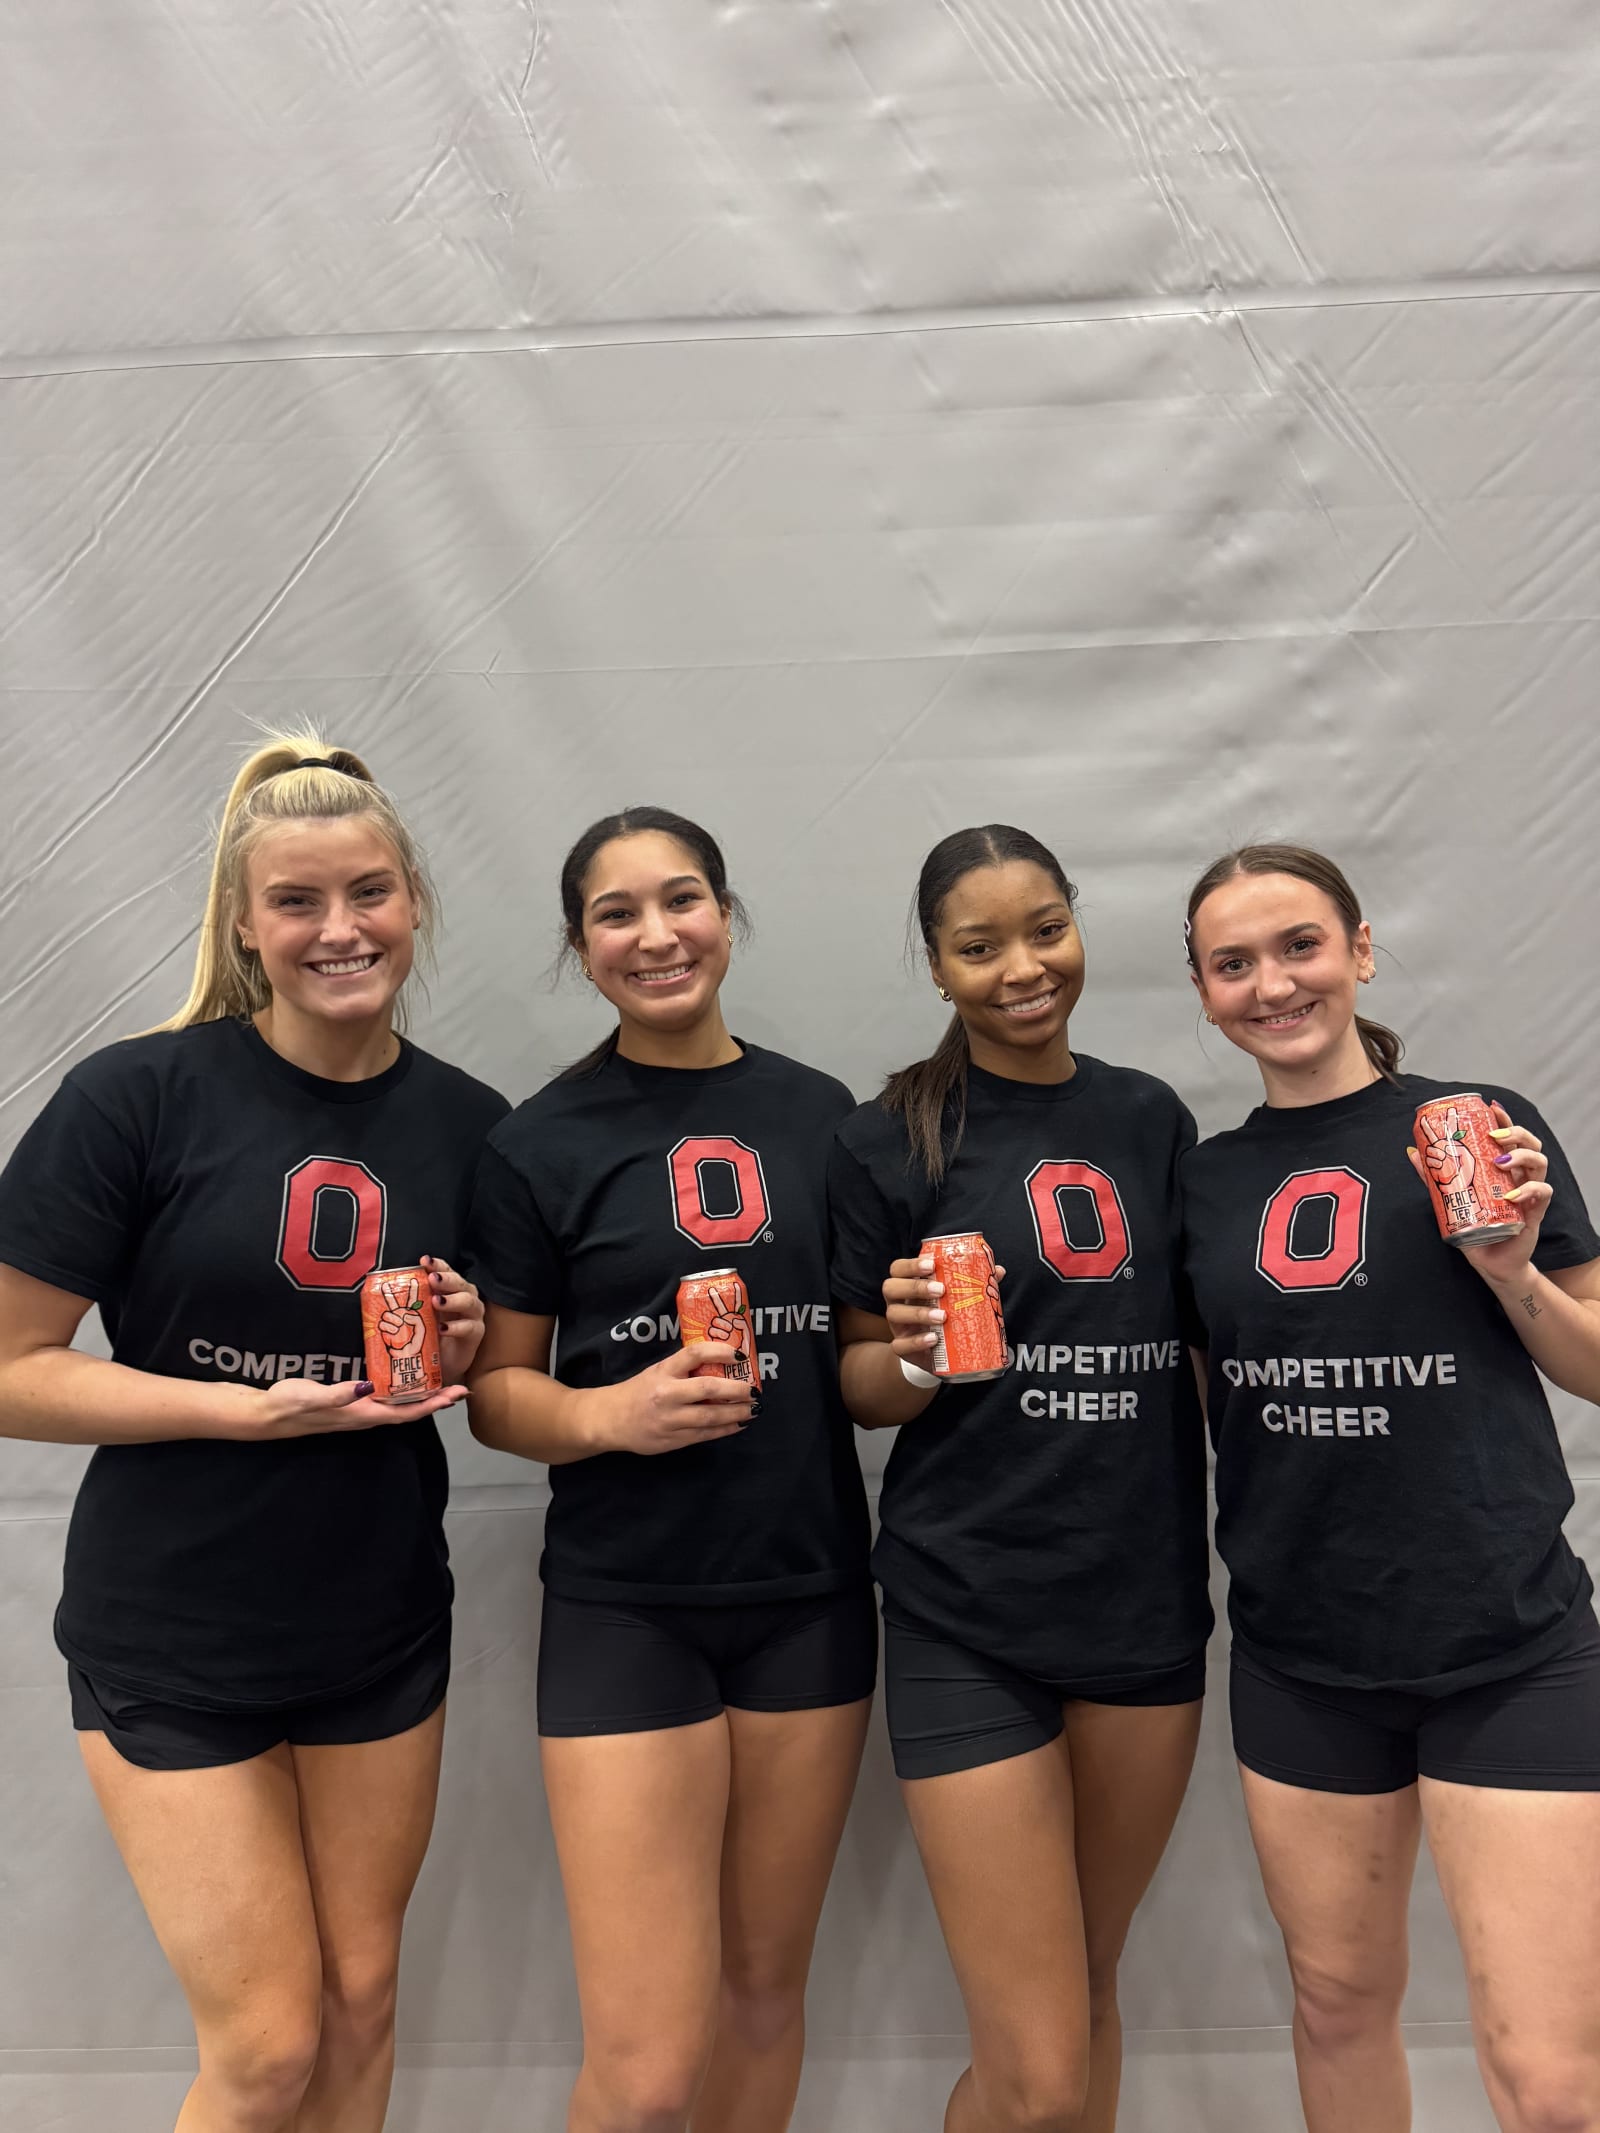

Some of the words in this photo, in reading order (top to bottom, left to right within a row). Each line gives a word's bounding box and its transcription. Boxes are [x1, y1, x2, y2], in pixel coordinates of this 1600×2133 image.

[667, 1135, 771, 1249] O
[1444, 1188, 1476, 1210] PEACE
[275, 1155, 387, 1293] O
[1024, 1159, 1132, 1282] O
[1255, 1165, 1370, 1293] O
[1520, 1294, 1542, 1320] Real
[393, 1355, 422, 1373] PEACE
[1020, 1388, 1139, 1421] CHEER
[1262, 1402, 1391, 1437] CHEER
